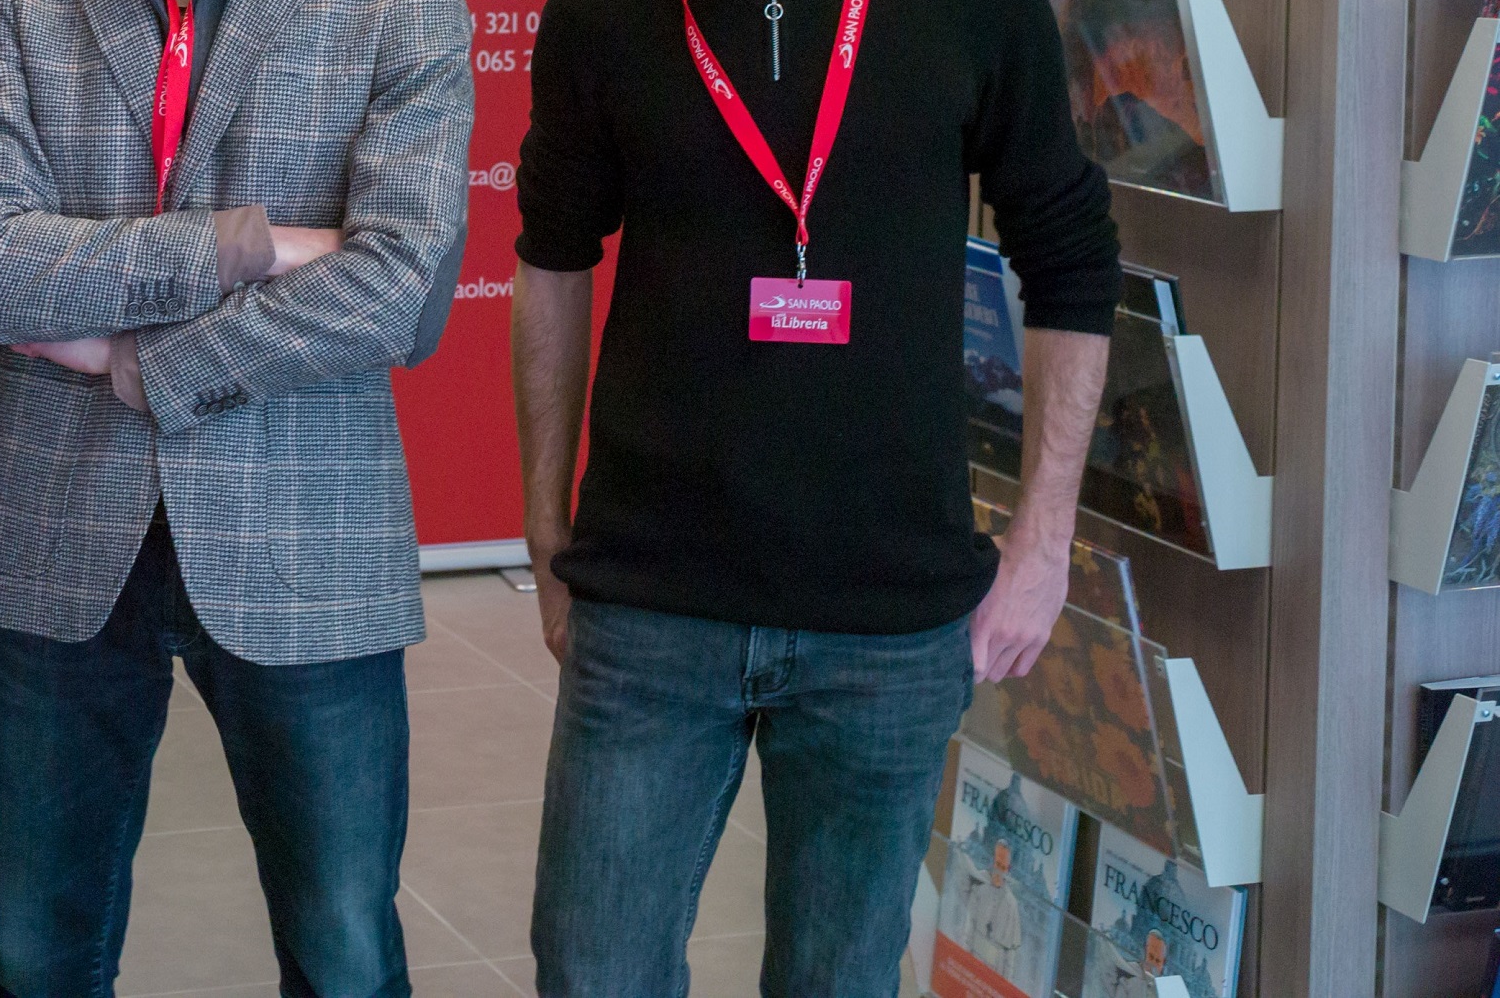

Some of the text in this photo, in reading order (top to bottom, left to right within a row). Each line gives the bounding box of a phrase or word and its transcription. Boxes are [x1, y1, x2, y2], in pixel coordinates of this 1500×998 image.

[485, 12, 518, 34] 321
[843, 20, 859, 43] SAN
[476, 50, 516, 72] 065
[687, 25, 718, 80] SAN PAOLO
[806, 157, 823, 192] PAOLO
[787, 298, 842, 311] SAN PAOLO
[961, 781, 1053, 857] FRANCESCO
[1104, 864, 1219, 951] FRANCESCO
